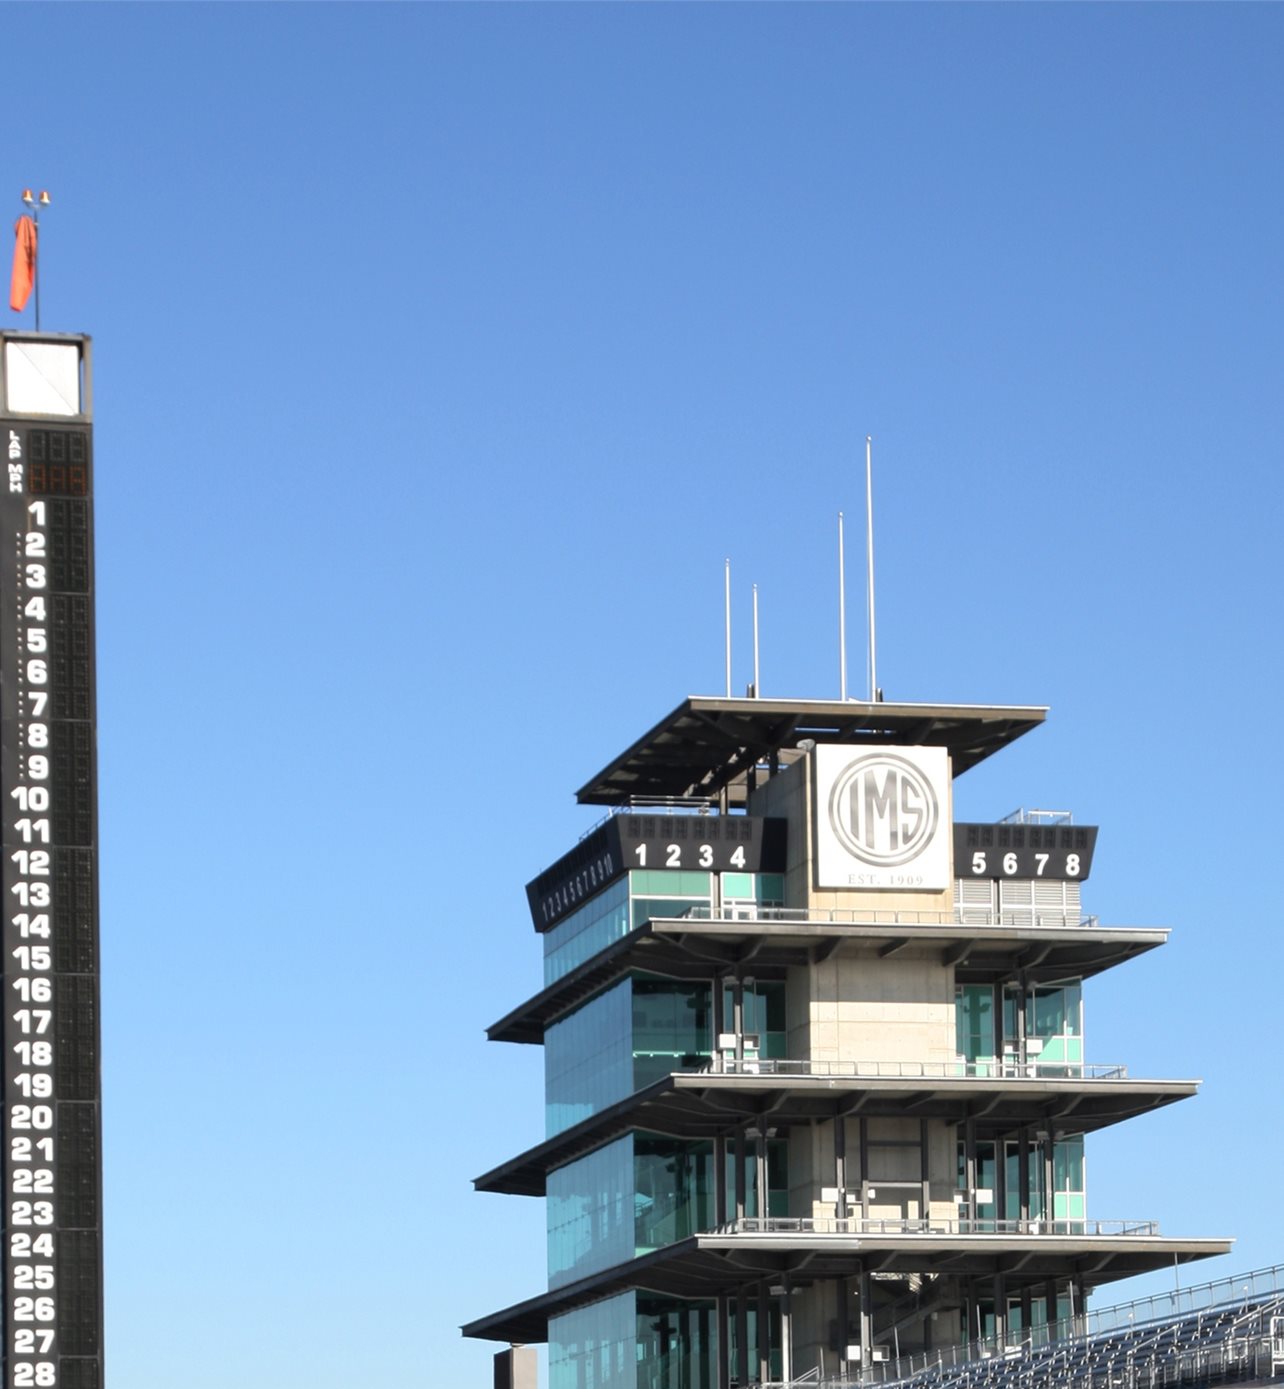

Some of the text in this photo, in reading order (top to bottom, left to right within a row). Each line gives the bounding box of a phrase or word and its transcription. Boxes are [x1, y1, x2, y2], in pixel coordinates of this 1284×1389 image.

[8, 429, 22, 460] LAP
[8, 463, 23, 494] MPH
[27, 500, 46, 527] 1
[25, 531, 46, 558] 2
[25, 563, 47, 589] 3
[24, 596, 47, 622] 4
[27, 627, 48, 654] 5
[26, 659, 48, 685] 6
[28, 691, 48, 717] 7
[27, 722, 49, 749] 8
[28, 754, 49, 781] 9
[10, 785, 50, 812] 10
[849, 768, 924, 852] IMS
[13, 818, 50, 844] 11
[10, 849, 50, 876] 12
[635, 843, 747, 869] 1 2 3 4
[971, 851, 1080, 877] 5 6 7 8
[847, 873, 924, 886] EST. 1909
[10, 881, 51, 908] 13
[11, 913, 51, 939] 14
[11, 945, 52, 971] 15
[12, 977, 52, 1003] 16
[12, 1008, 52, 1035] 17
[13, 1040, 53, 1067] 18
[13, 1072, 53, 1099] 19
[10, 1104, 53, 1130] 20
[11, 1136, 54, 1162] 21
[12, 1168, 54, 1194] 22
[11, 1200, 54, 1226] 23
[10, 1232, 55, 1258] 24
[13, 1264, 55, 1290] 25
[13, 1296, 56, 1322] 26
[14, 1328, 56, 1354] 27
[13, 1361, 56, 1388] 28
